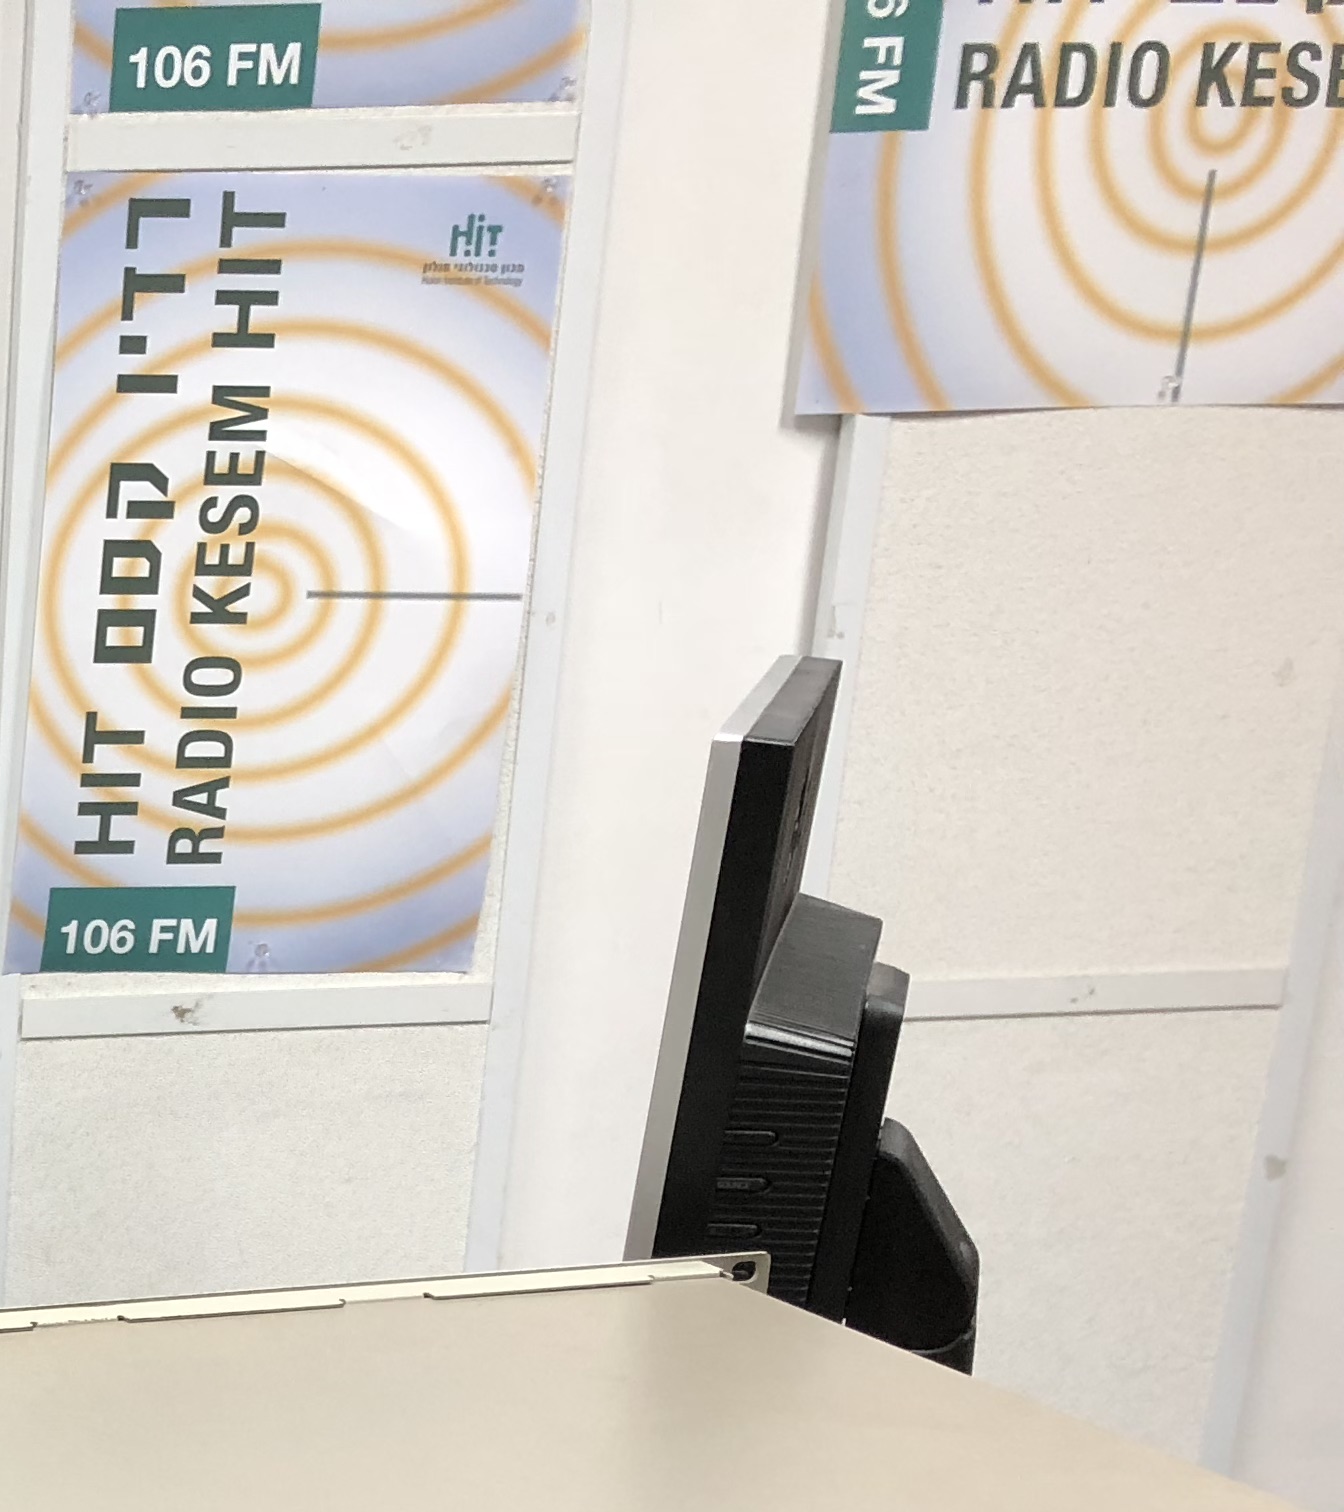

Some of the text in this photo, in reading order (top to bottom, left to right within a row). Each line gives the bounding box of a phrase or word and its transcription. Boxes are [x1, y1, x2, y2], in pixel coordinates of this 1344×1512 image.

[128, 42, 301, 89] 106 FM
[855, 35, 904, 116] FM
[954, 40, 1170, 110] RADIO
[74, 198, 191, 855] רדיו קסם HIT
[167, 191, 287, 865] RADIO KESEM HIT
[60, 919, 217, 956] 106 FM
